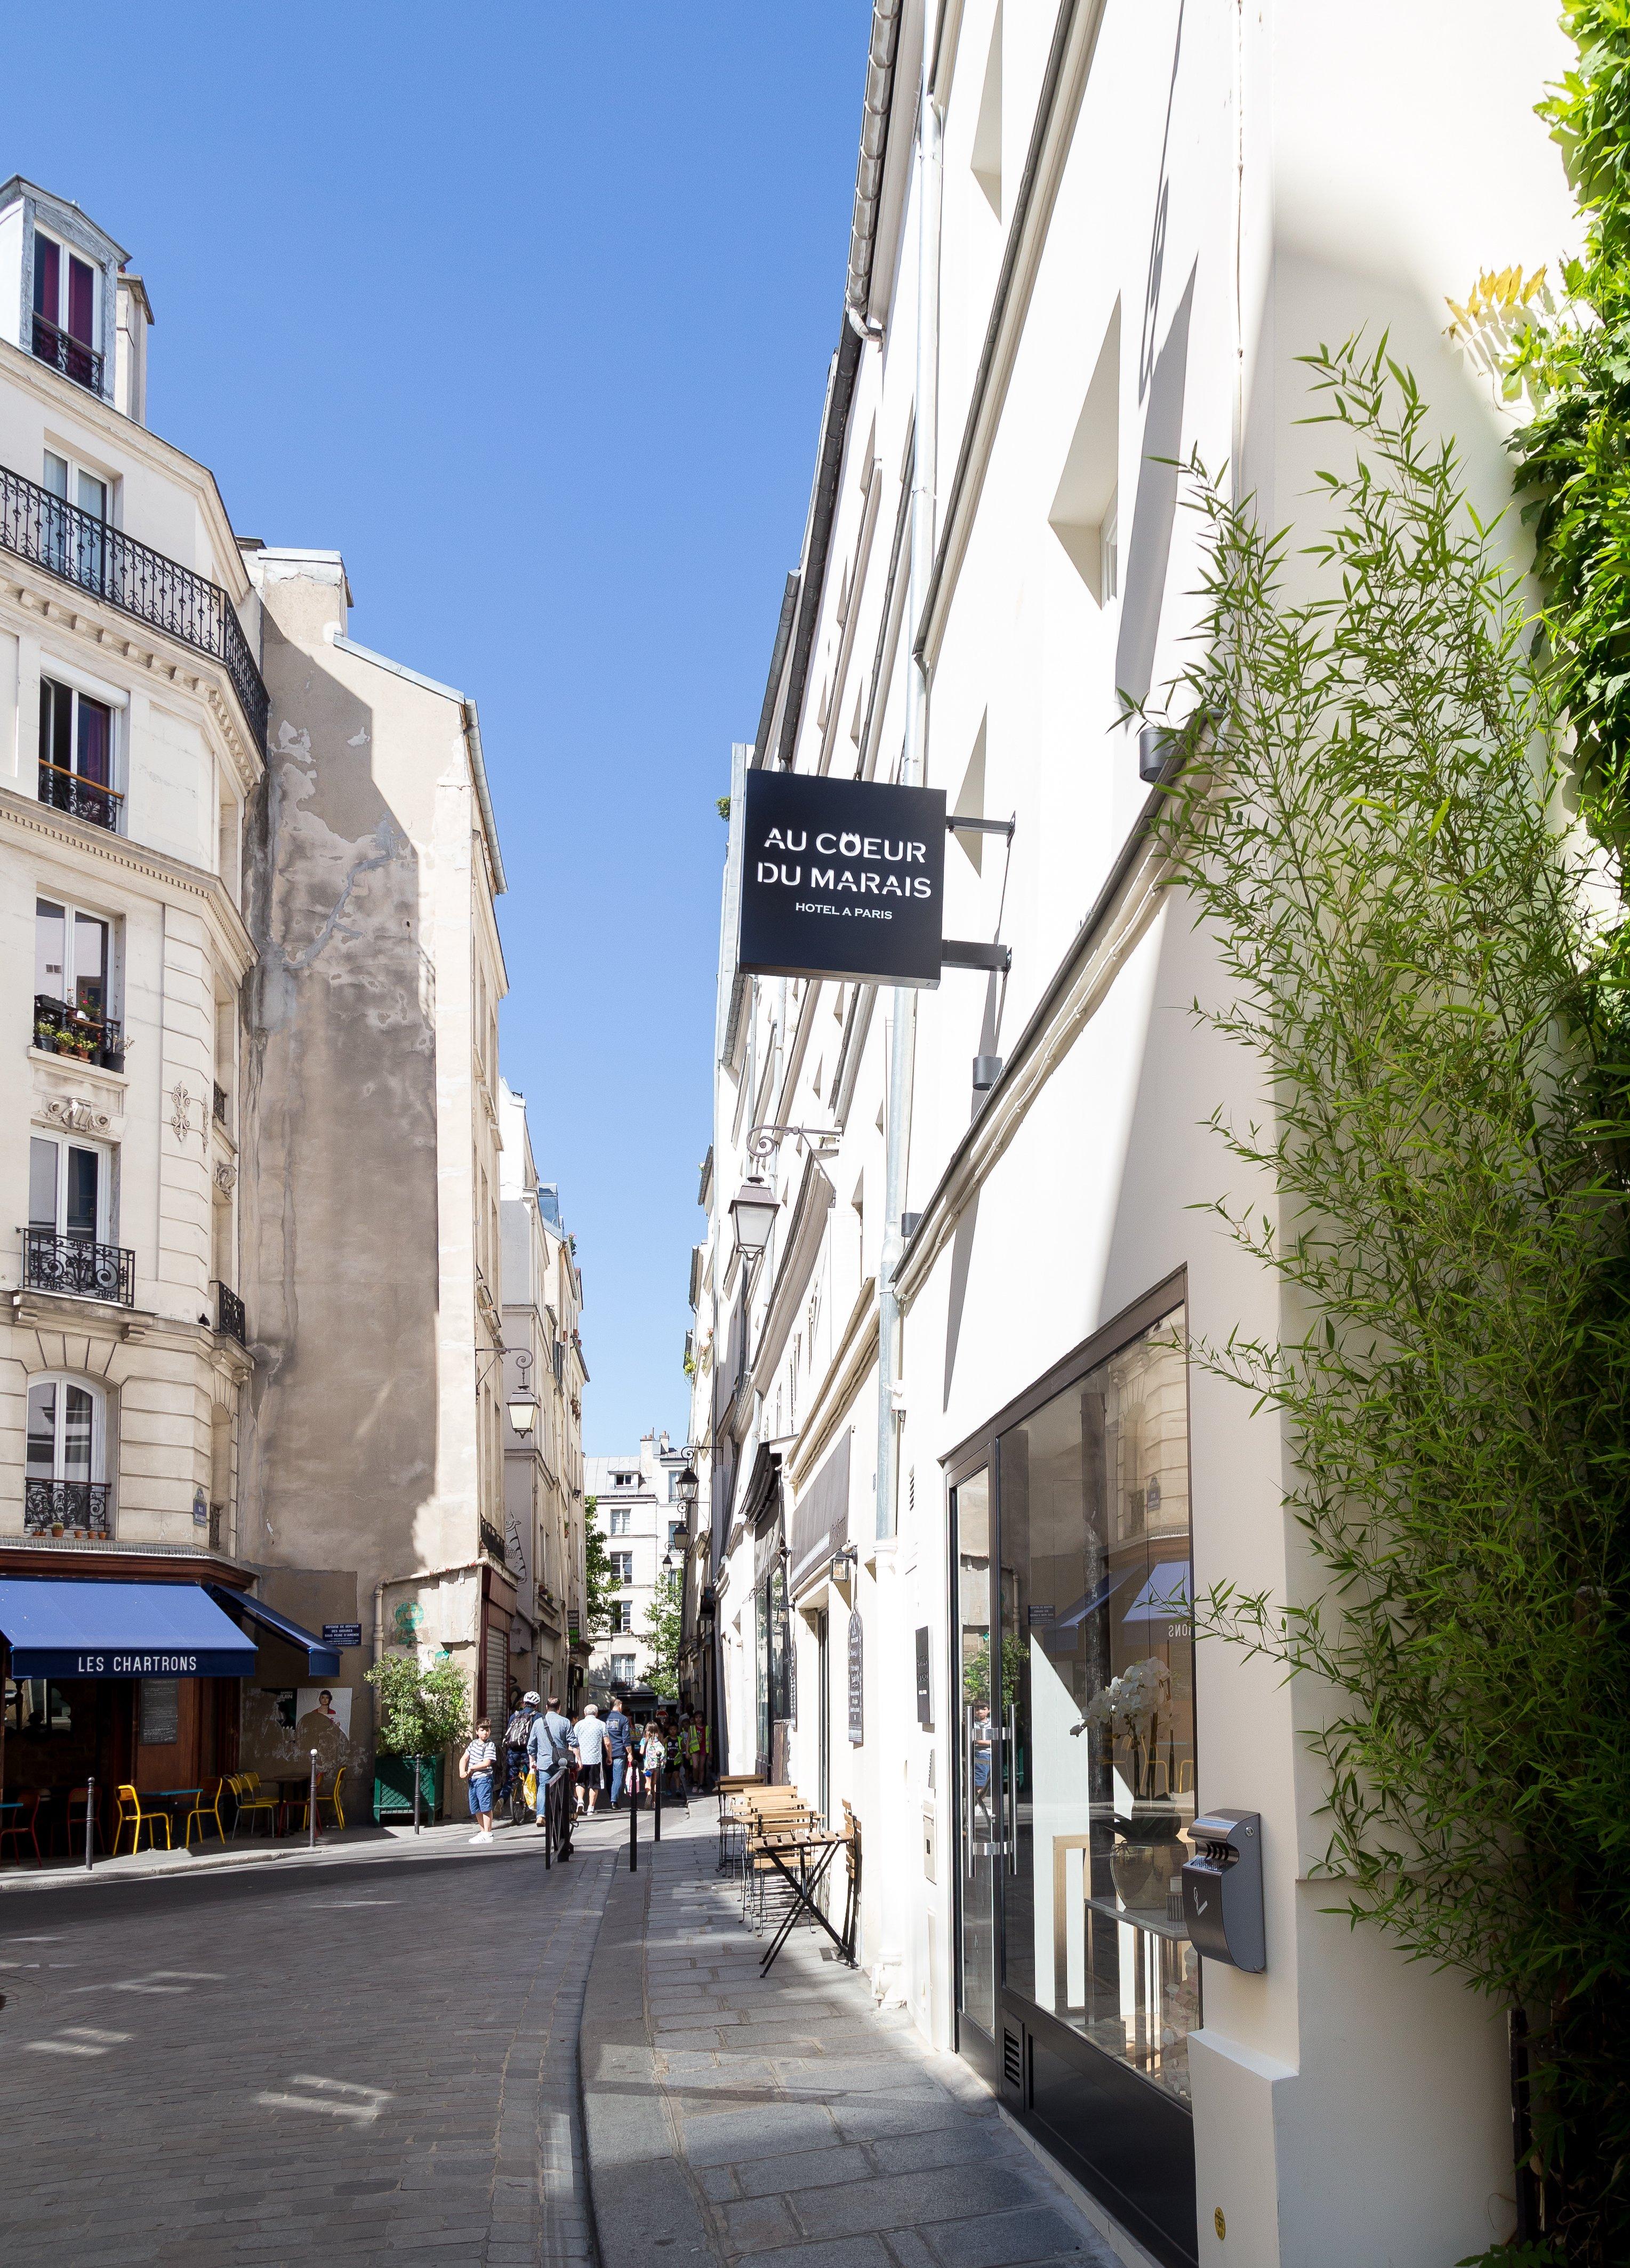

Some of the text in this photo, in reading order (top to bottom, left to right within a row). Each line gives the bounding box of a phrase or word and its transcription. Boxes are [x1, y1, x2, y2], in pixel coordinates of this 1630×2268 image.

[764, 828, 807, 851] AU
[757, 862, 932, 899] DU MARAIS
[796, 902, 893, 920] HOTEL A PARIS
[78, 1656, 196, 1672] LES CHARTRONS
